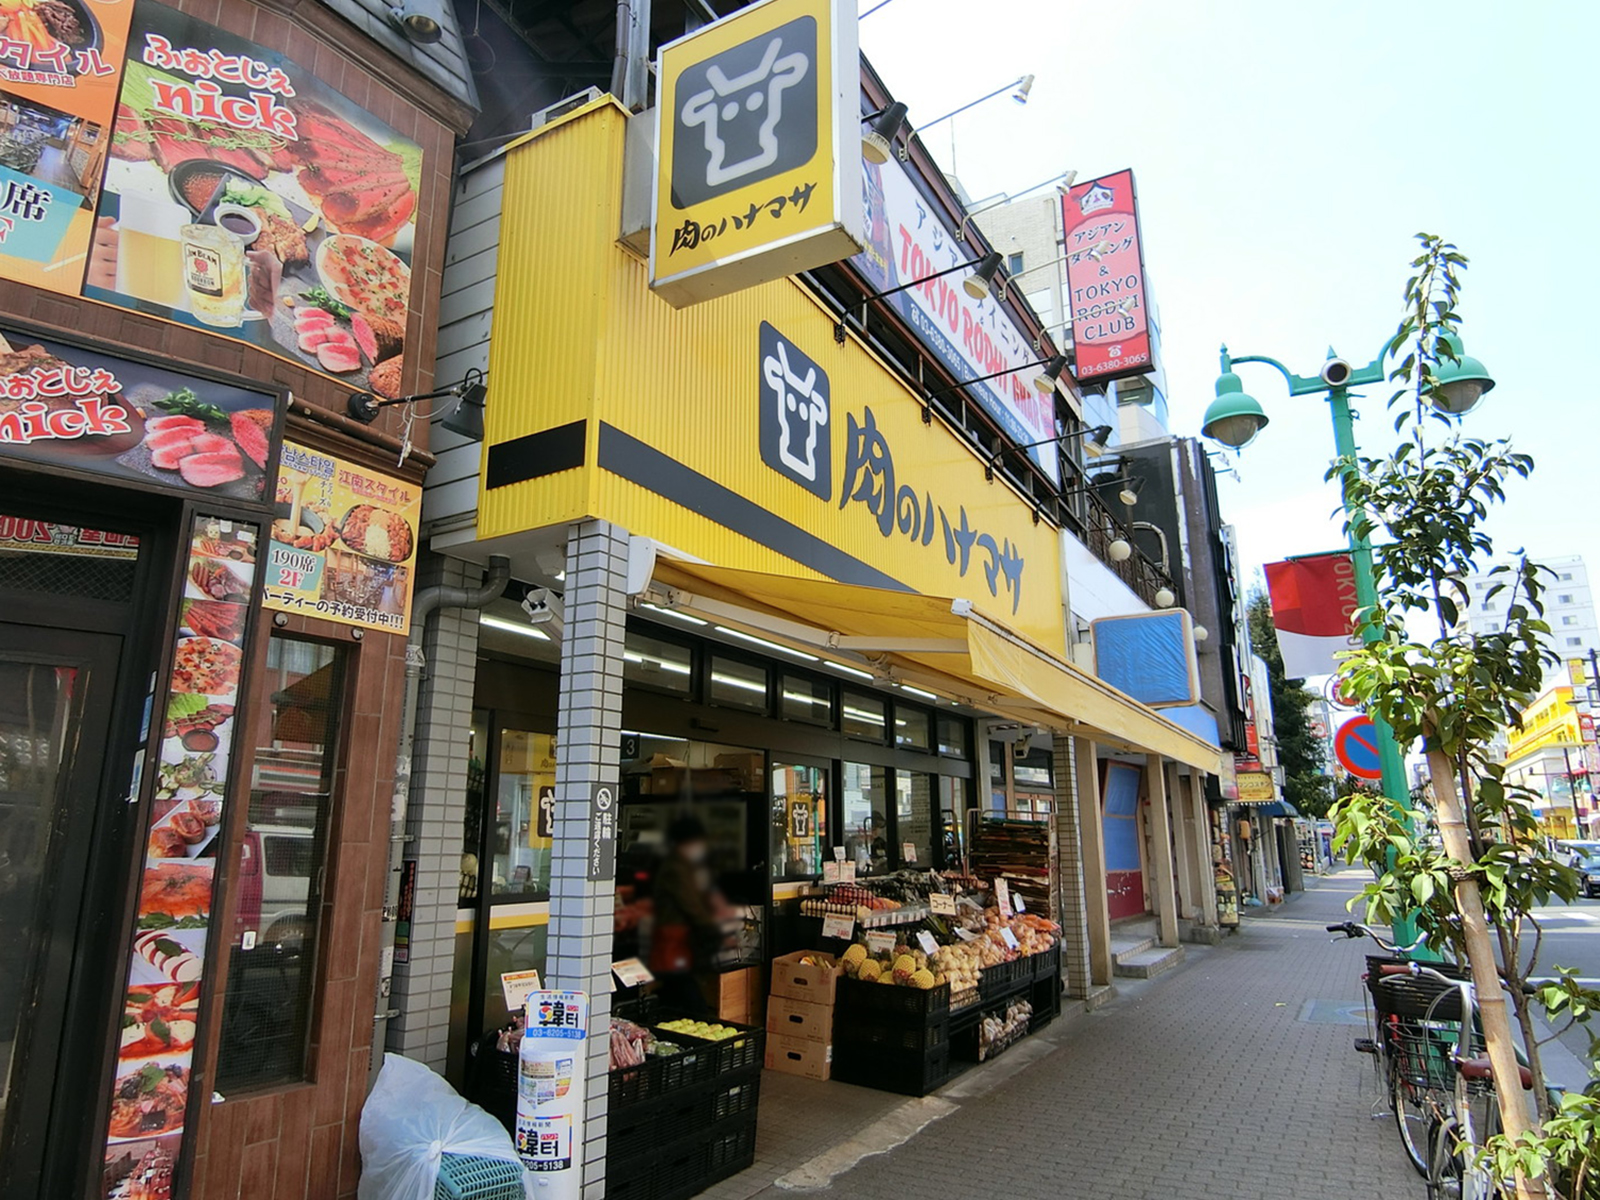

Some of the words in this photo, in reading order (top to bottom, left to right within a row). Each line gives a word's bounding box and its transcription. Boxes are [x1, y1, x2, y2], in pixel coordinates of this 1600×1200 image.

[150, 79, 298, 141] nick
[669, 182, 817, 257] 肉のハナマサ
[1074, 220, 1126, 245] アジアン
[1098, 265, 1109, 277] &
[1074, 274, 1138, 302] TOKYO
[899, 223, 959, 333] TOKYO
[962, 306, 1008, 394] RODHI
[1012, 373, 1040, 433] GHAR
[1084, 315, 1136, 340] CLUB
[1081, 352, 1147, 375] 03-6380-3065
[339, 470, 411, 503] 江南スタイル
[838, 405, 1024, 616] 肉のハナマサ
[272, 549, 316, 573] 190席
[279, 568, 304, 588] 2F
[626, 739, 635, 756] 3
[592, 811, 602, 876] ご遠慮ください
[532, 1028, 581, 1039] 03-6205-5138
